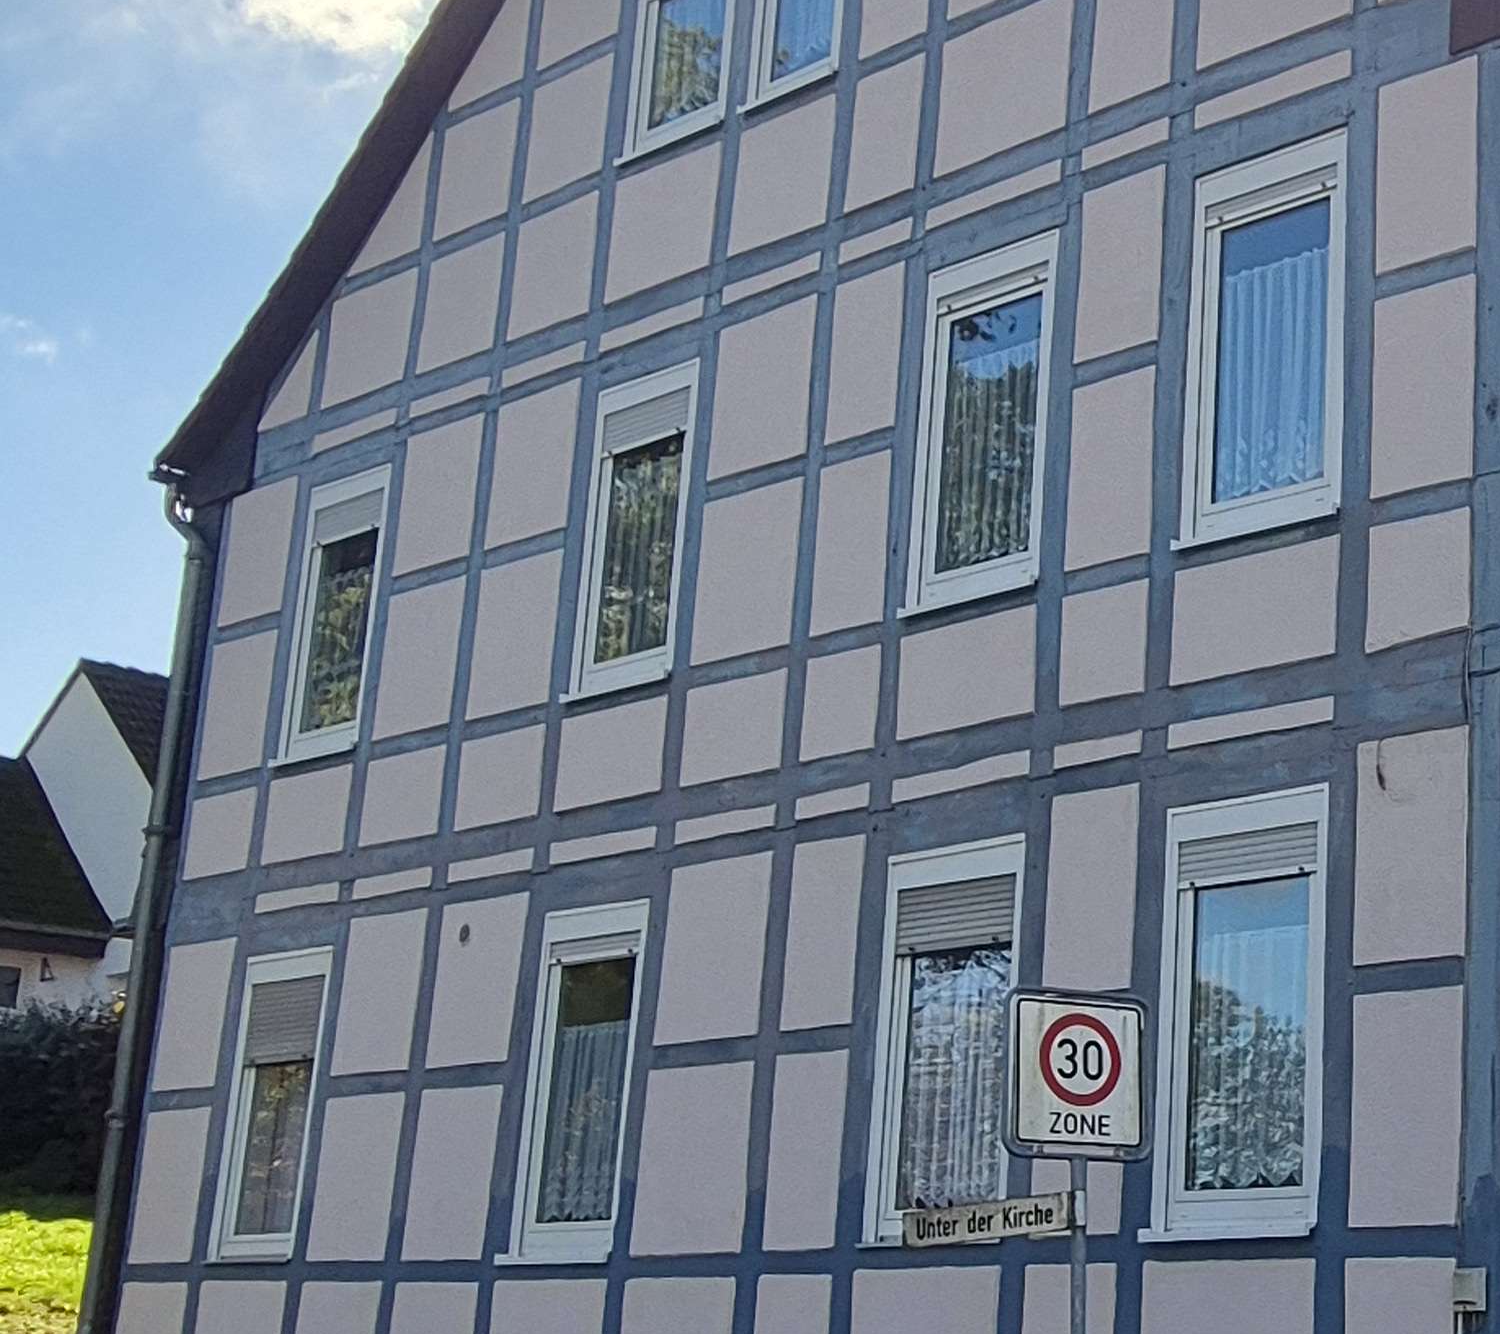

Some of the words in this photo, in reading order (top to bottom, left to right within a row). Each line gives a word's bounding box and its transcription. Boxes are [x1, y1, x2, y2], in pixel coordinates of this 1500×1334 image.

[1056, 1038, 1103, 1081] 30
[1049, 1112, 1111, 1136] ZONE
[916, 1218, 958, 1241] Unter
[967, 1211, 994, 1234] der
[1002, 1205, 1054, 1230] Kirche
